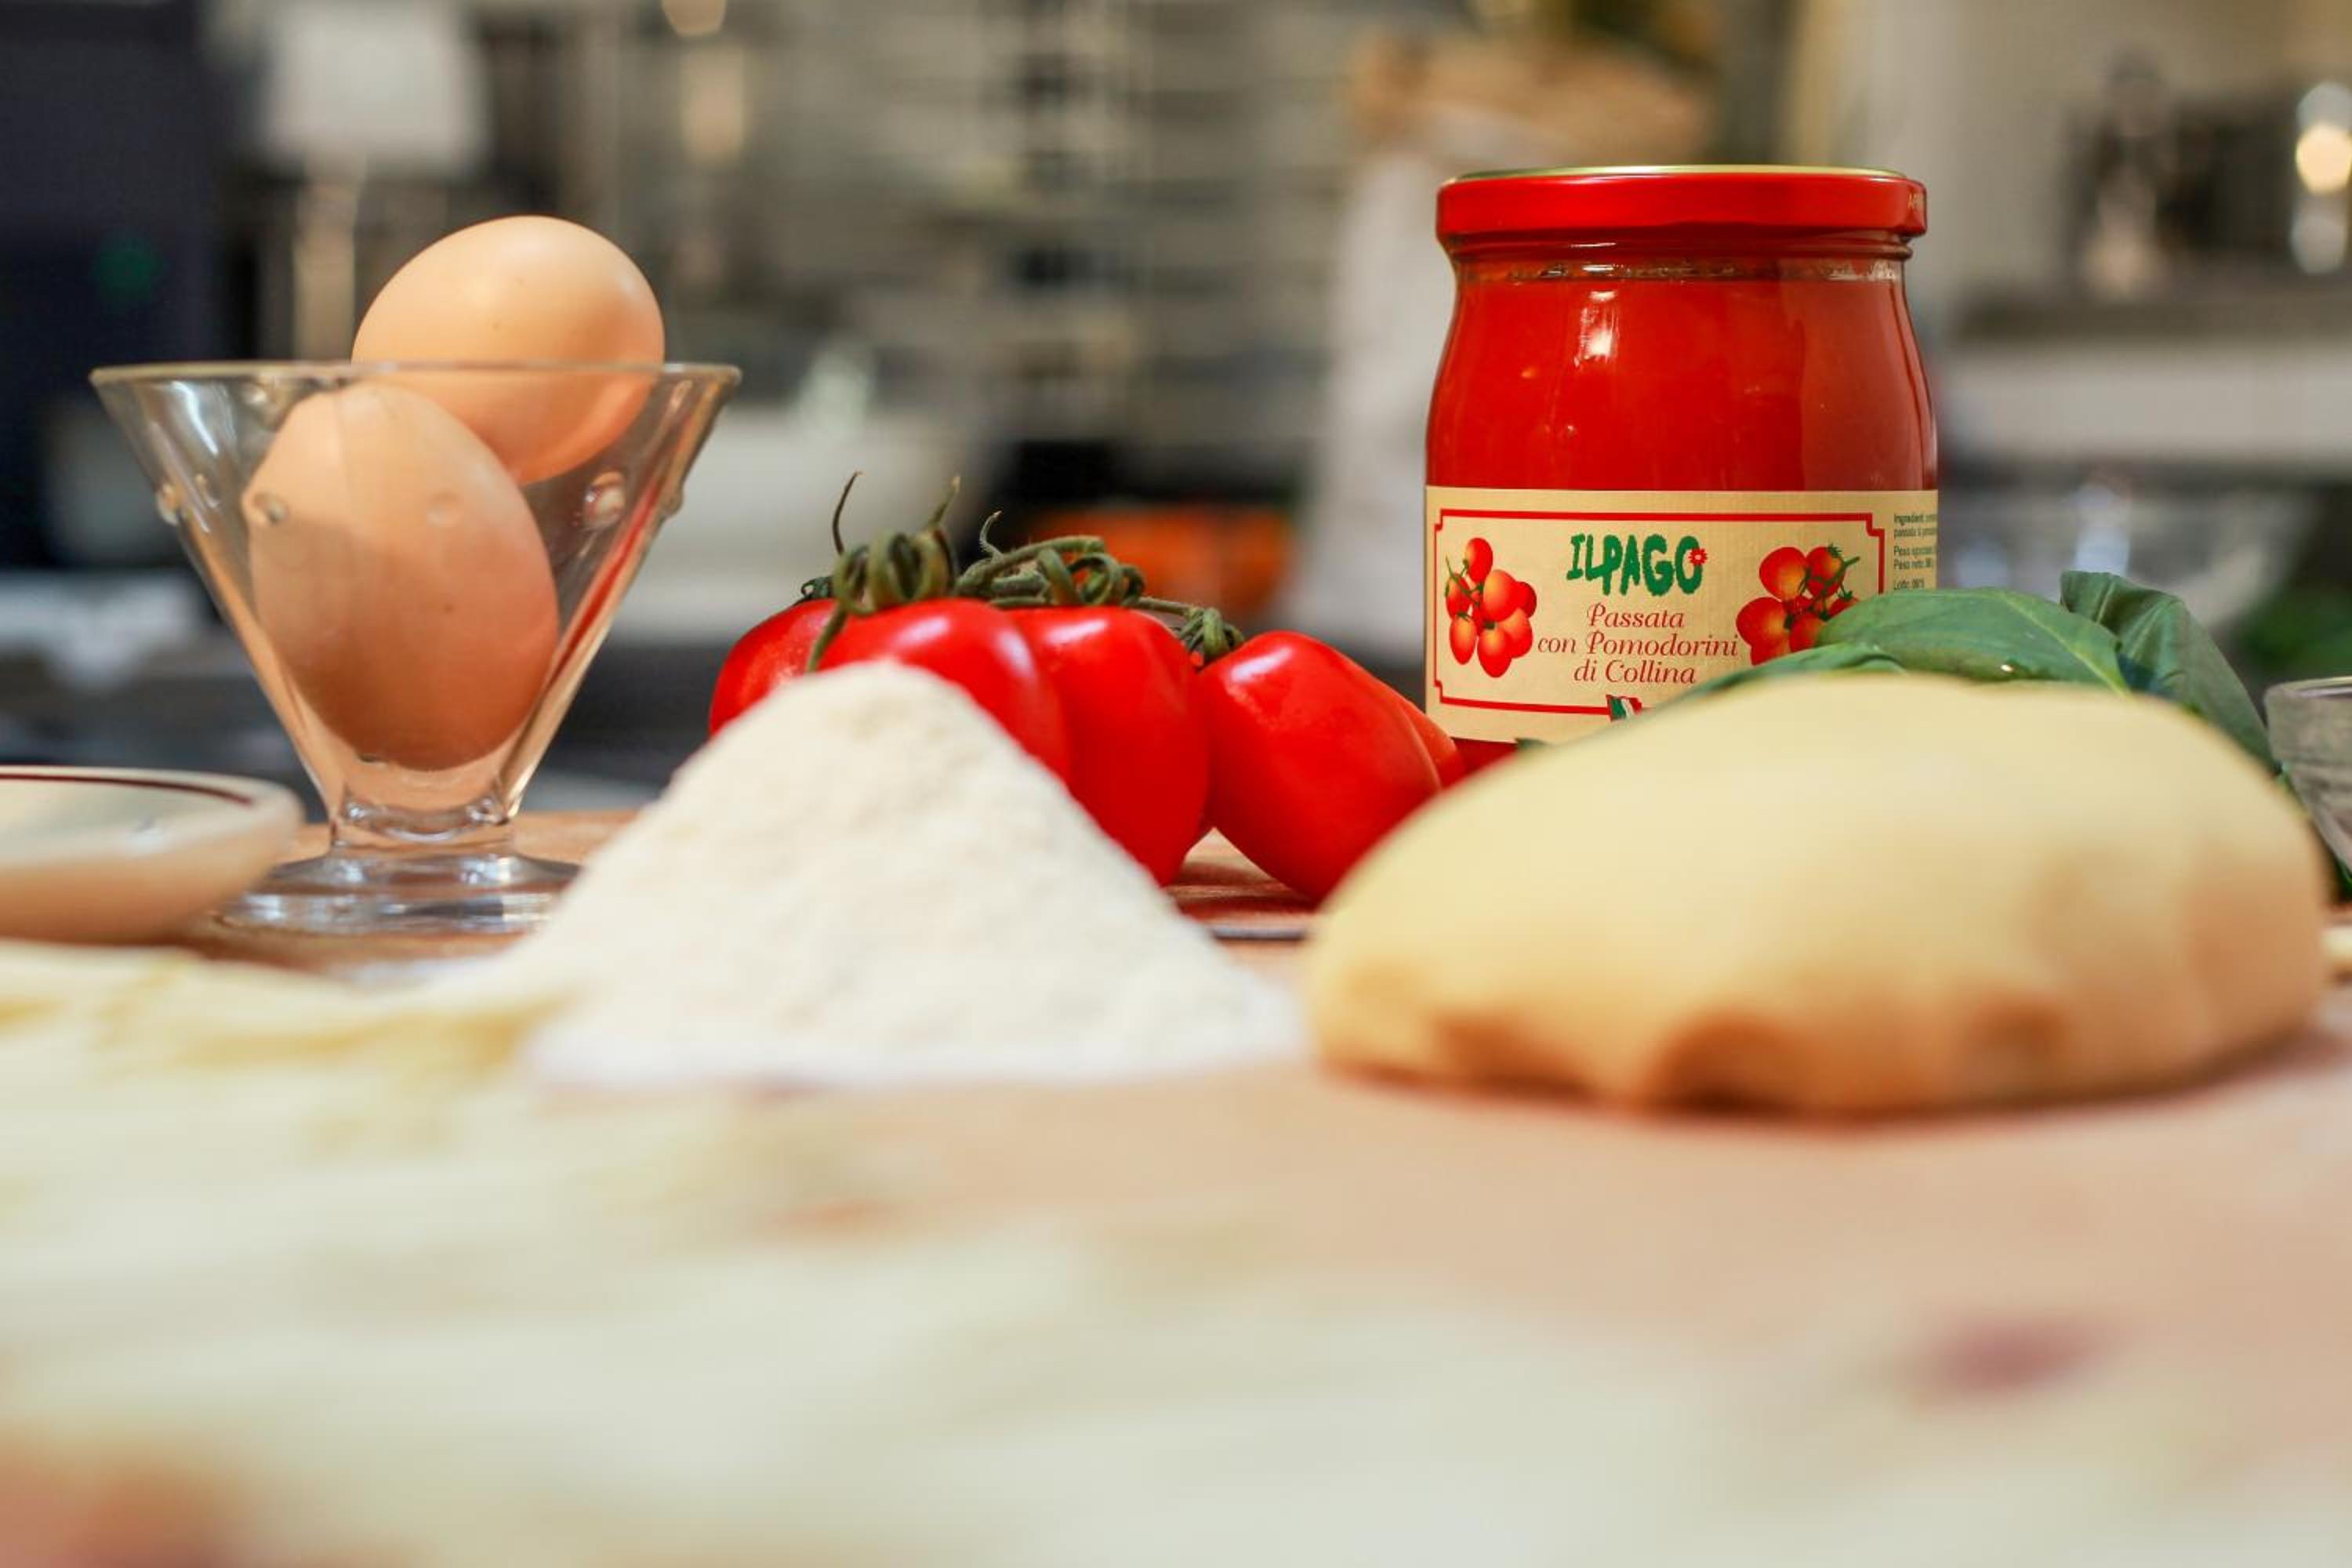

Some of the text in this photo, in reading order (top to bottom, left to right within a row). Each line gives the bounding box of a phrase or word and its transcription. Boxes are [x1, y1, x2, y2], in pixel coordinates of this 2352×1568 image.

[1587, 602, 1685, 628] Passata
[1537, 630, 1739, 656] con Pomodorini
[1573, 659, 1697, 684] di Collina
